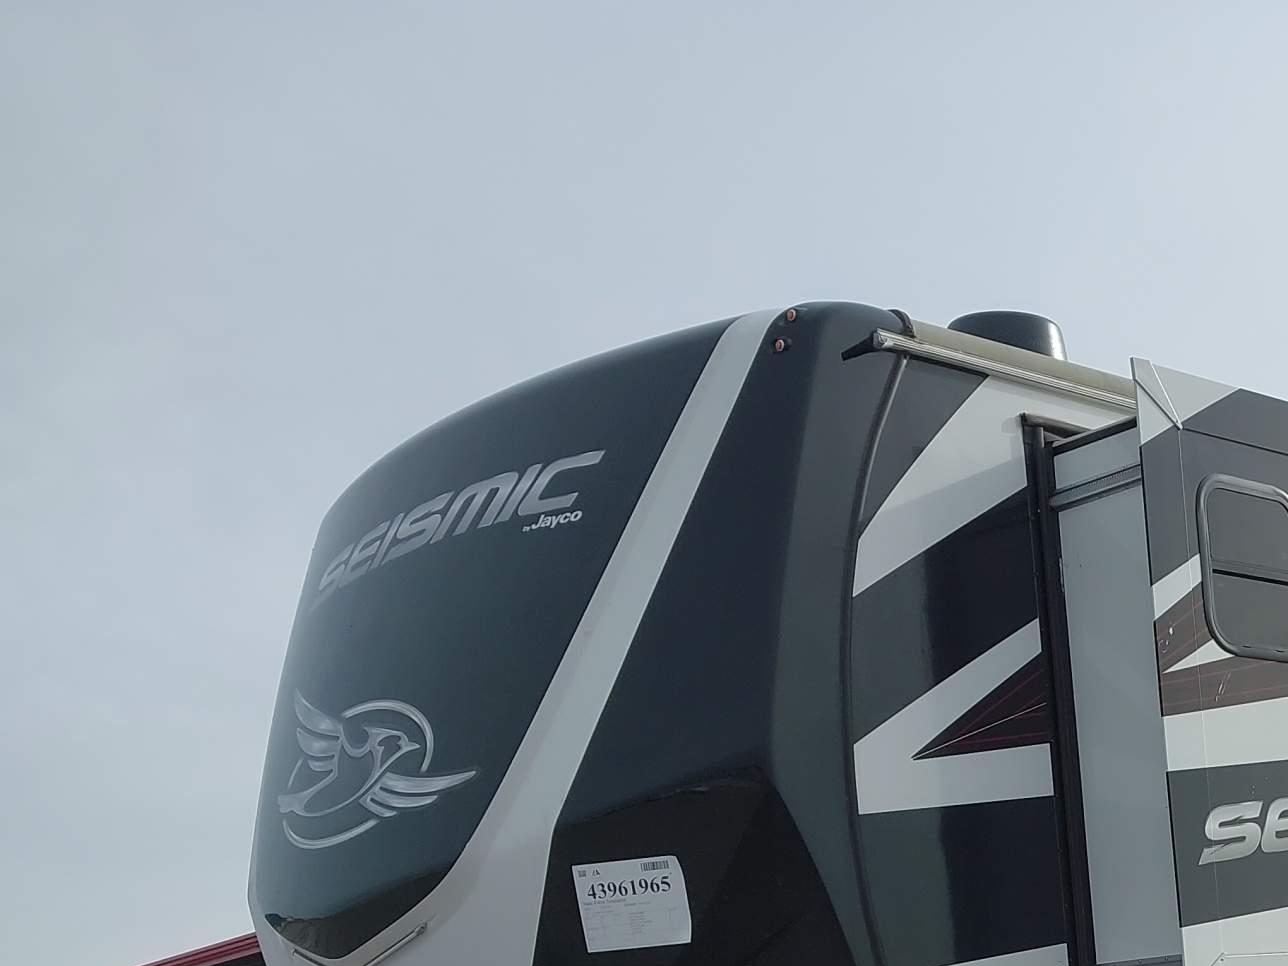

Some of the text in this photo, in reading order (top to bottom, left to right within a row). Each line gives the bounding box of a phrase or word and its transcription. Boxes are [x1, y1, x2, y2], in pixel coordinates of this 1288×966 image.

[309, 449, 607, 609] SEISMIC
[531, 510, 583, 531] Jayco
[587, 875, 672, 900] 43961965
